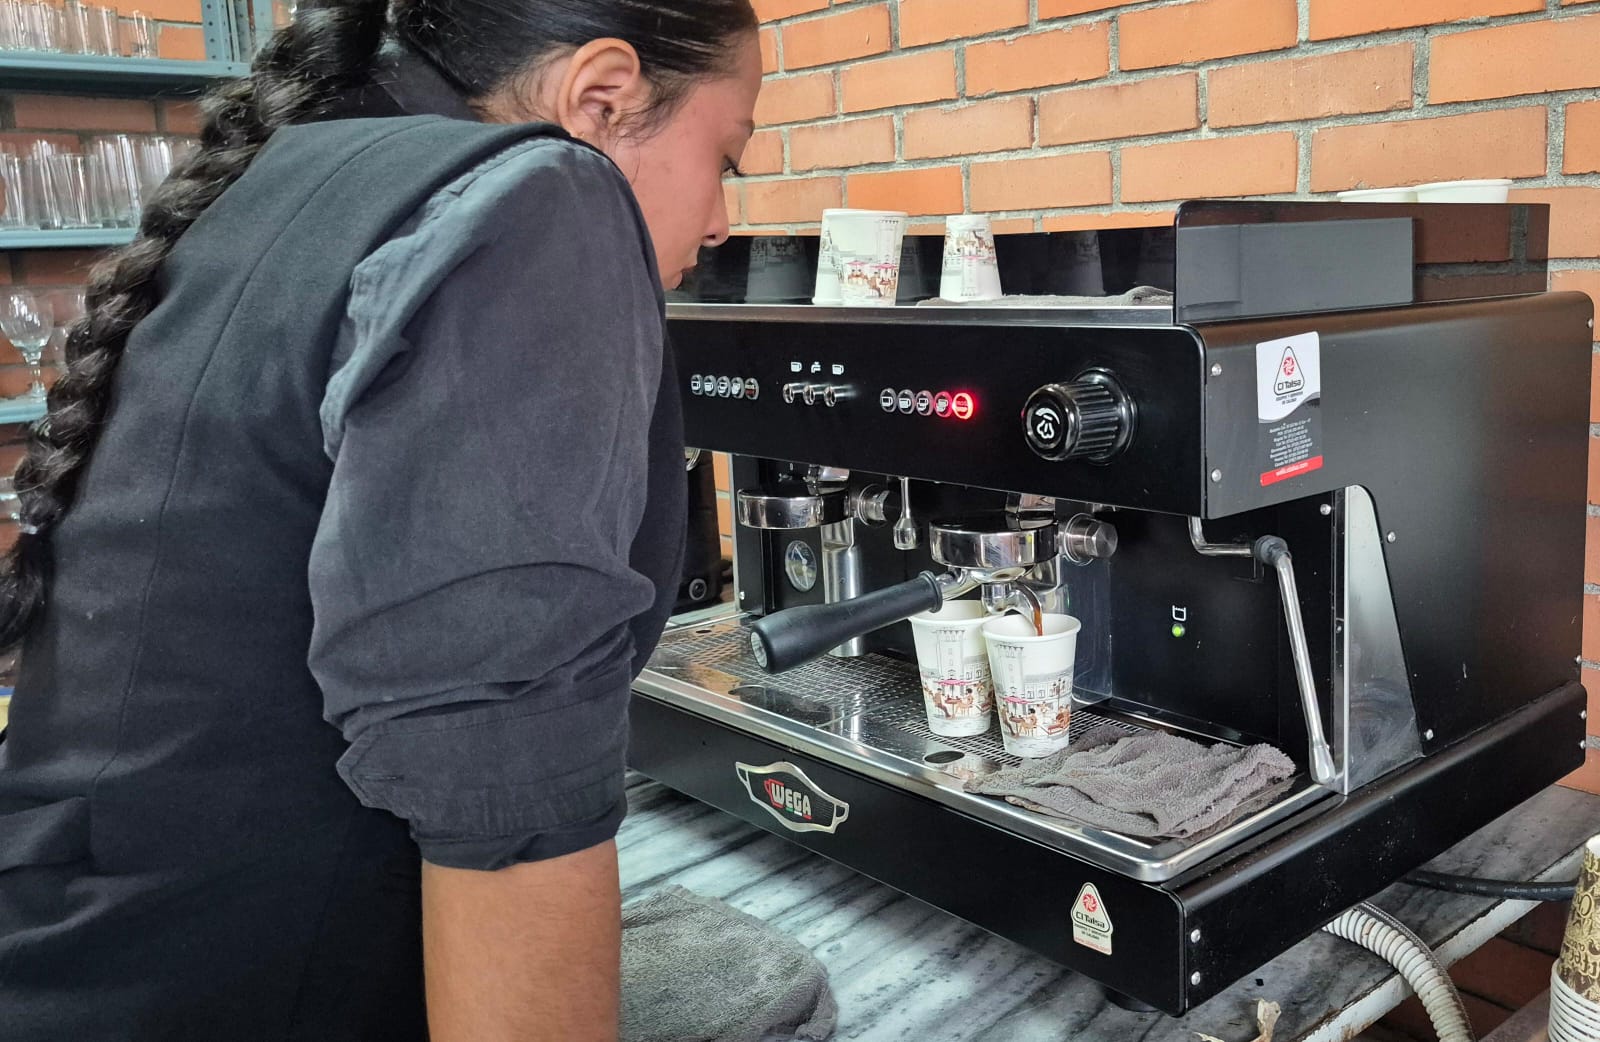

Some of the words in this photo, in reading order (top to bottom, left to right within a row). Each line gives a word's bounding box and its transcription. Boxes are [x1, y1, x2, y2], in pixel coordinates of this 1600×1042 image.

[1284, 379, 1302, 389] Talsa
[771, 782, 812, 816] WEGA
[1084, 914, 1105, 928] Talsa
